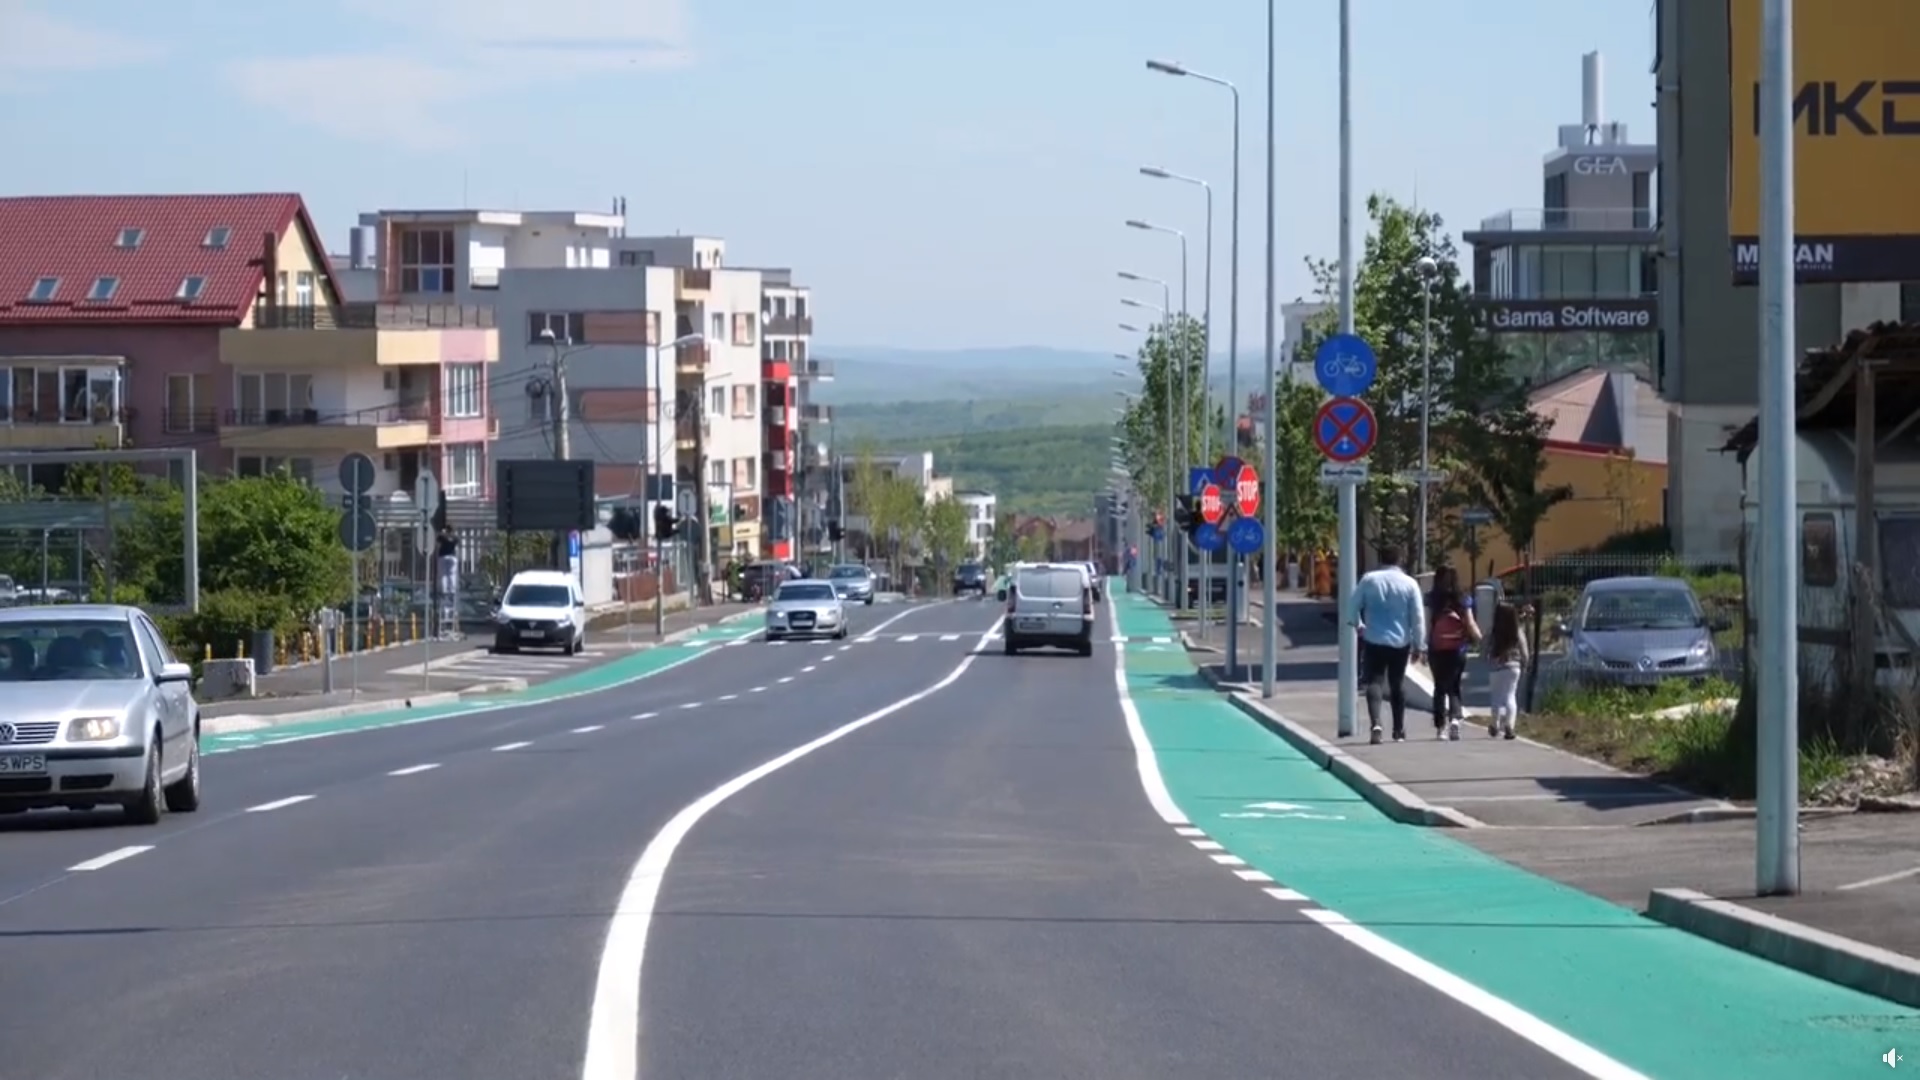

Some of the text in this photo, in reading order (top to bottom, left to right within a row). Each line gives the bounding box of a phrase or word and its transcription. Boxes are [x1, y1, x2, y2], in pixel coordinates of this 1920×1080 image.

[1574, 156, 1627, 175] GEA
[1493, 305, 1649, 327] Gama Software
[1237, 481, 1259, 502] STOP
[1202, 495, 1221, 511] STOP
